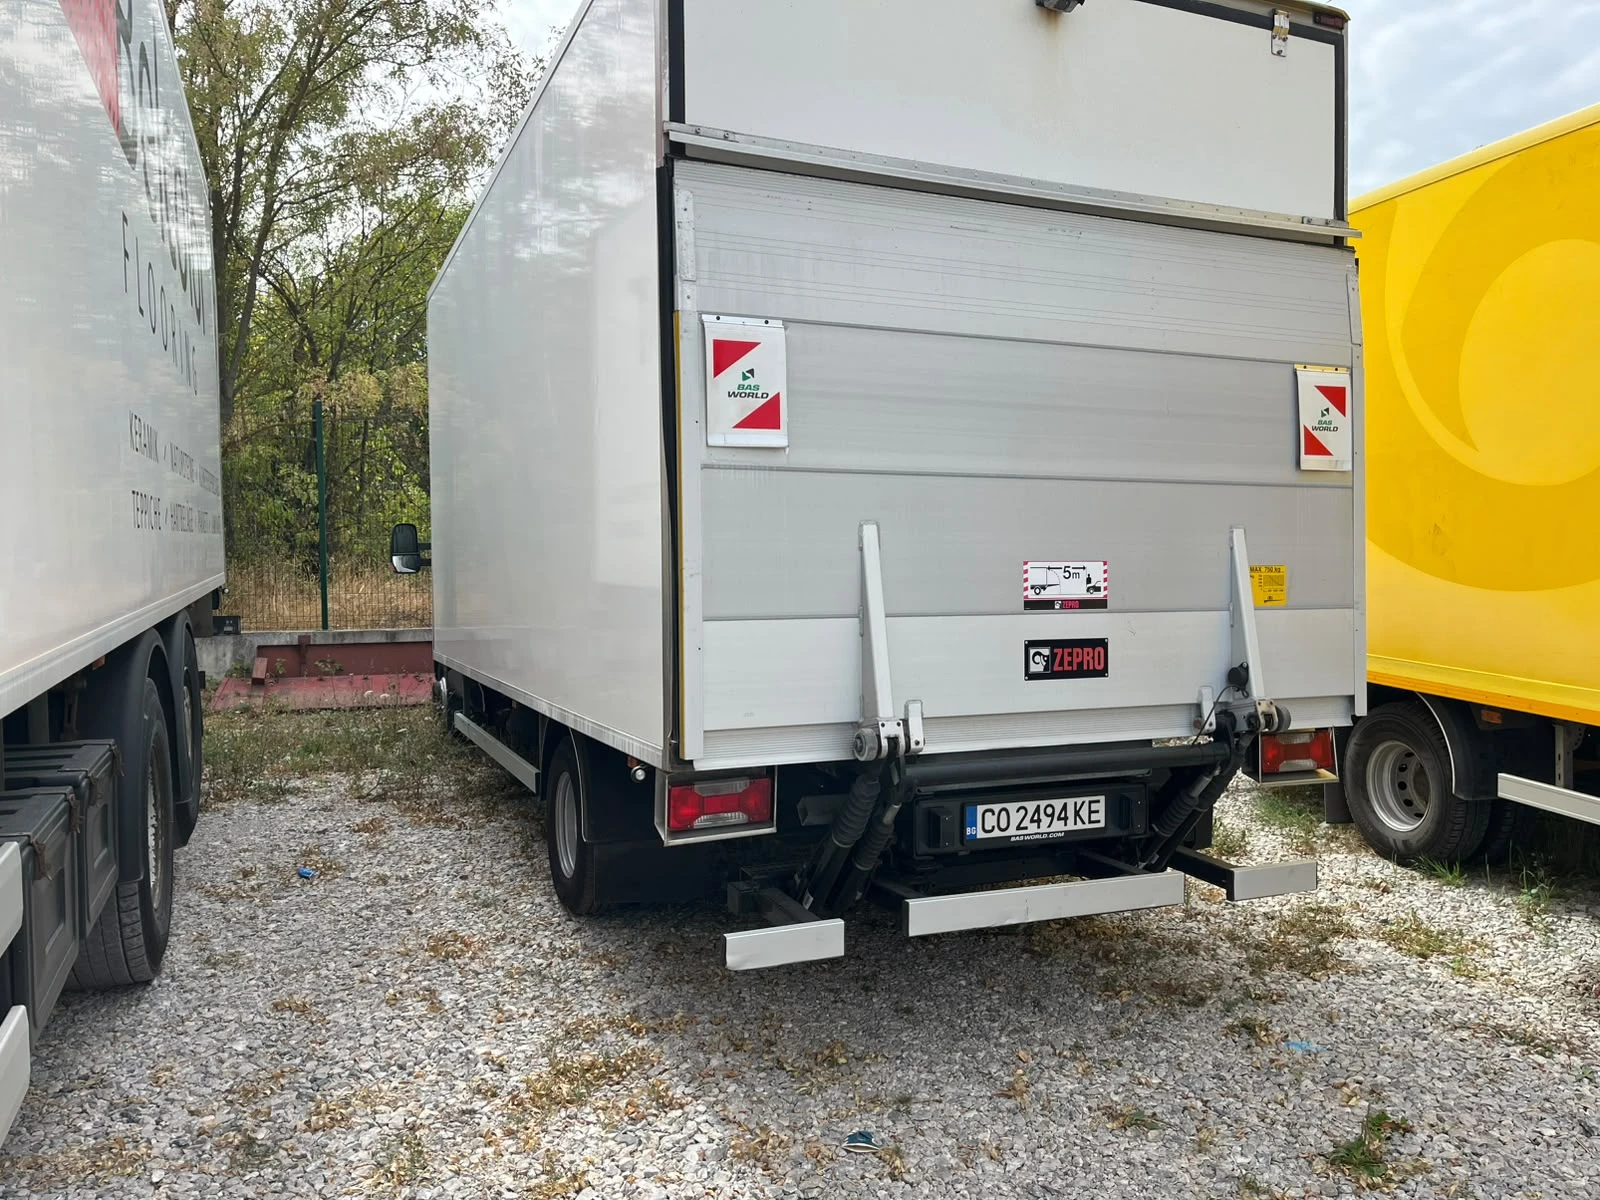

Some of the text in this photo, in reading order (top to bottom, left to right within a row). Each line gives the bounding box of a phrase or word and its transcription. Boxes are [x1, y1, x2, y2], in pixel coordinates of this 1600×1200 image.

[122, 211, 199, 396] FLOORING
[727, 391, 769, 399] WORLD
[128, 410, 160, 463] KERAMIK
[131, 489, 162, 530] TEPPICHE
[1062, 601, 1080, 609] ZEPRO
[1053, 647, 1105, 672] ZEPRO
[966, 827, 976, 835] BG
